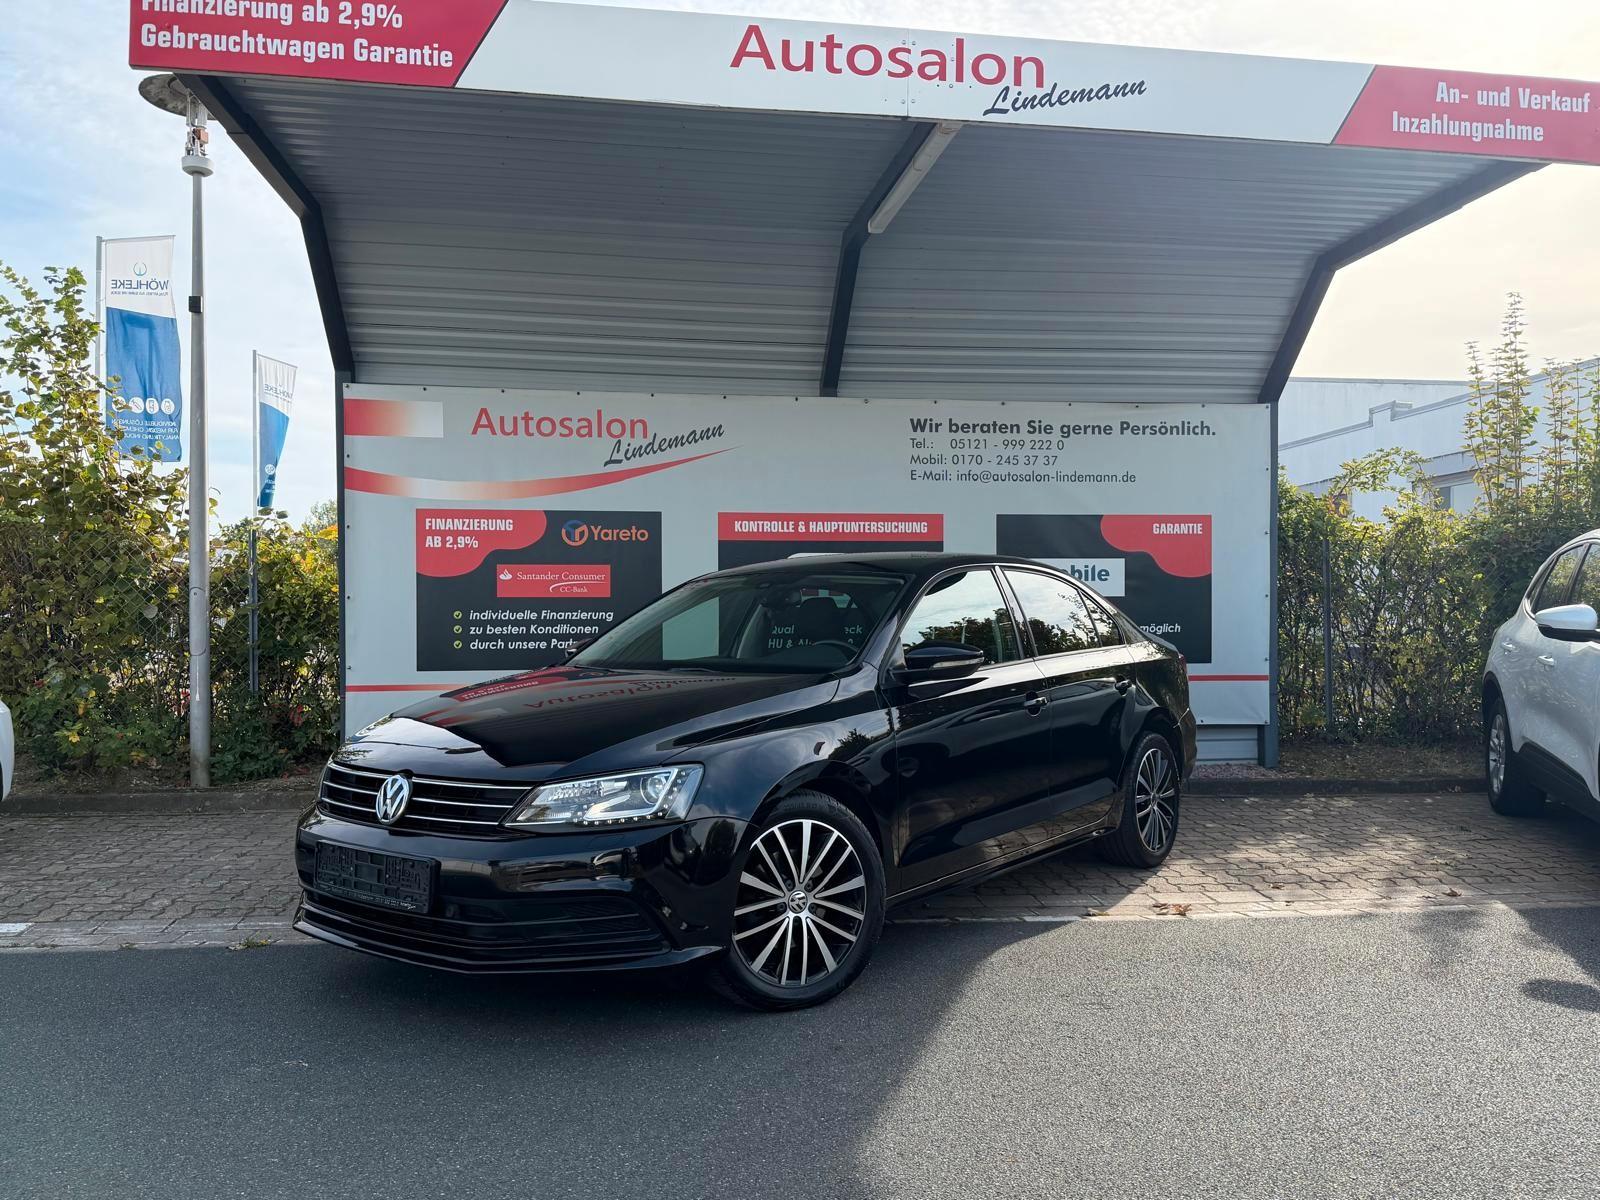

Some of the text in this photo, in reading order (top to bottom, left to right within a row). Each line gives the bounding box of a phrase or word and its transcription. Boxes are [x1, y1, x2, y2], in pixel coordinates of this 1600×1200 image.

[302, 0, 329, 23] ab
[338, 1, 403, 29] 2,9%
[141, 23, 453, 67] Gebrauchtwagen Garantie
[729, 24, 1045, 88] Autosalon
[983, 78, 1147, 116] Lindemann
[1435, 81, 1591, 113] An- und Verkauf
[1392, 111, 1545, 142] Inzahlungnahme
[471, 408, 648, 439] Autosalon
[909, 418, 1216, 438] Wir beraten Sie gerne Persönlich.
[603, 424, 725, 467] Lindemann
[910, 438, 934, 450] Tel.:
[950, 438, 988, 450] 05121
[1002, 439, 1025, 451] 999
[1029, 440, 1053, 451] 222
[1057, 440, 1065, 451] 0
[910, 453, 947, 466] Mobil:
[951, 454, 983, 466] 0170
[996, 455, 1019, 466] 245
[1023, 455, 1039, 466] 37
[1043, 455, 1058, 466] 37
[910, 469, 1137, 484] E-Mail: info@autosalon-lindemann.de
[425, 518, 514, 531] FINANZIERUNG
[734, 520, 928, 534] KONTROLLE & HAUPTUNTERSUCHUNG
[1152, 523, 1203, 535] GARANTIE
[590, 525, 649, 542] Yareto
[425, 535, 479, 550] AB 2,9%
[517, 571, 606, 581] Santander Consumer
[559, 585, 589, 594] CC-Bank
[469, 610, 614, 622] individuelle Finanzierung
[469, 624, 599, 635] zu besten Konditionen
[469, 638, 504, 650] durch
[508, 641, 548, 650] unsere
[768, 638, 783, 649] HU
